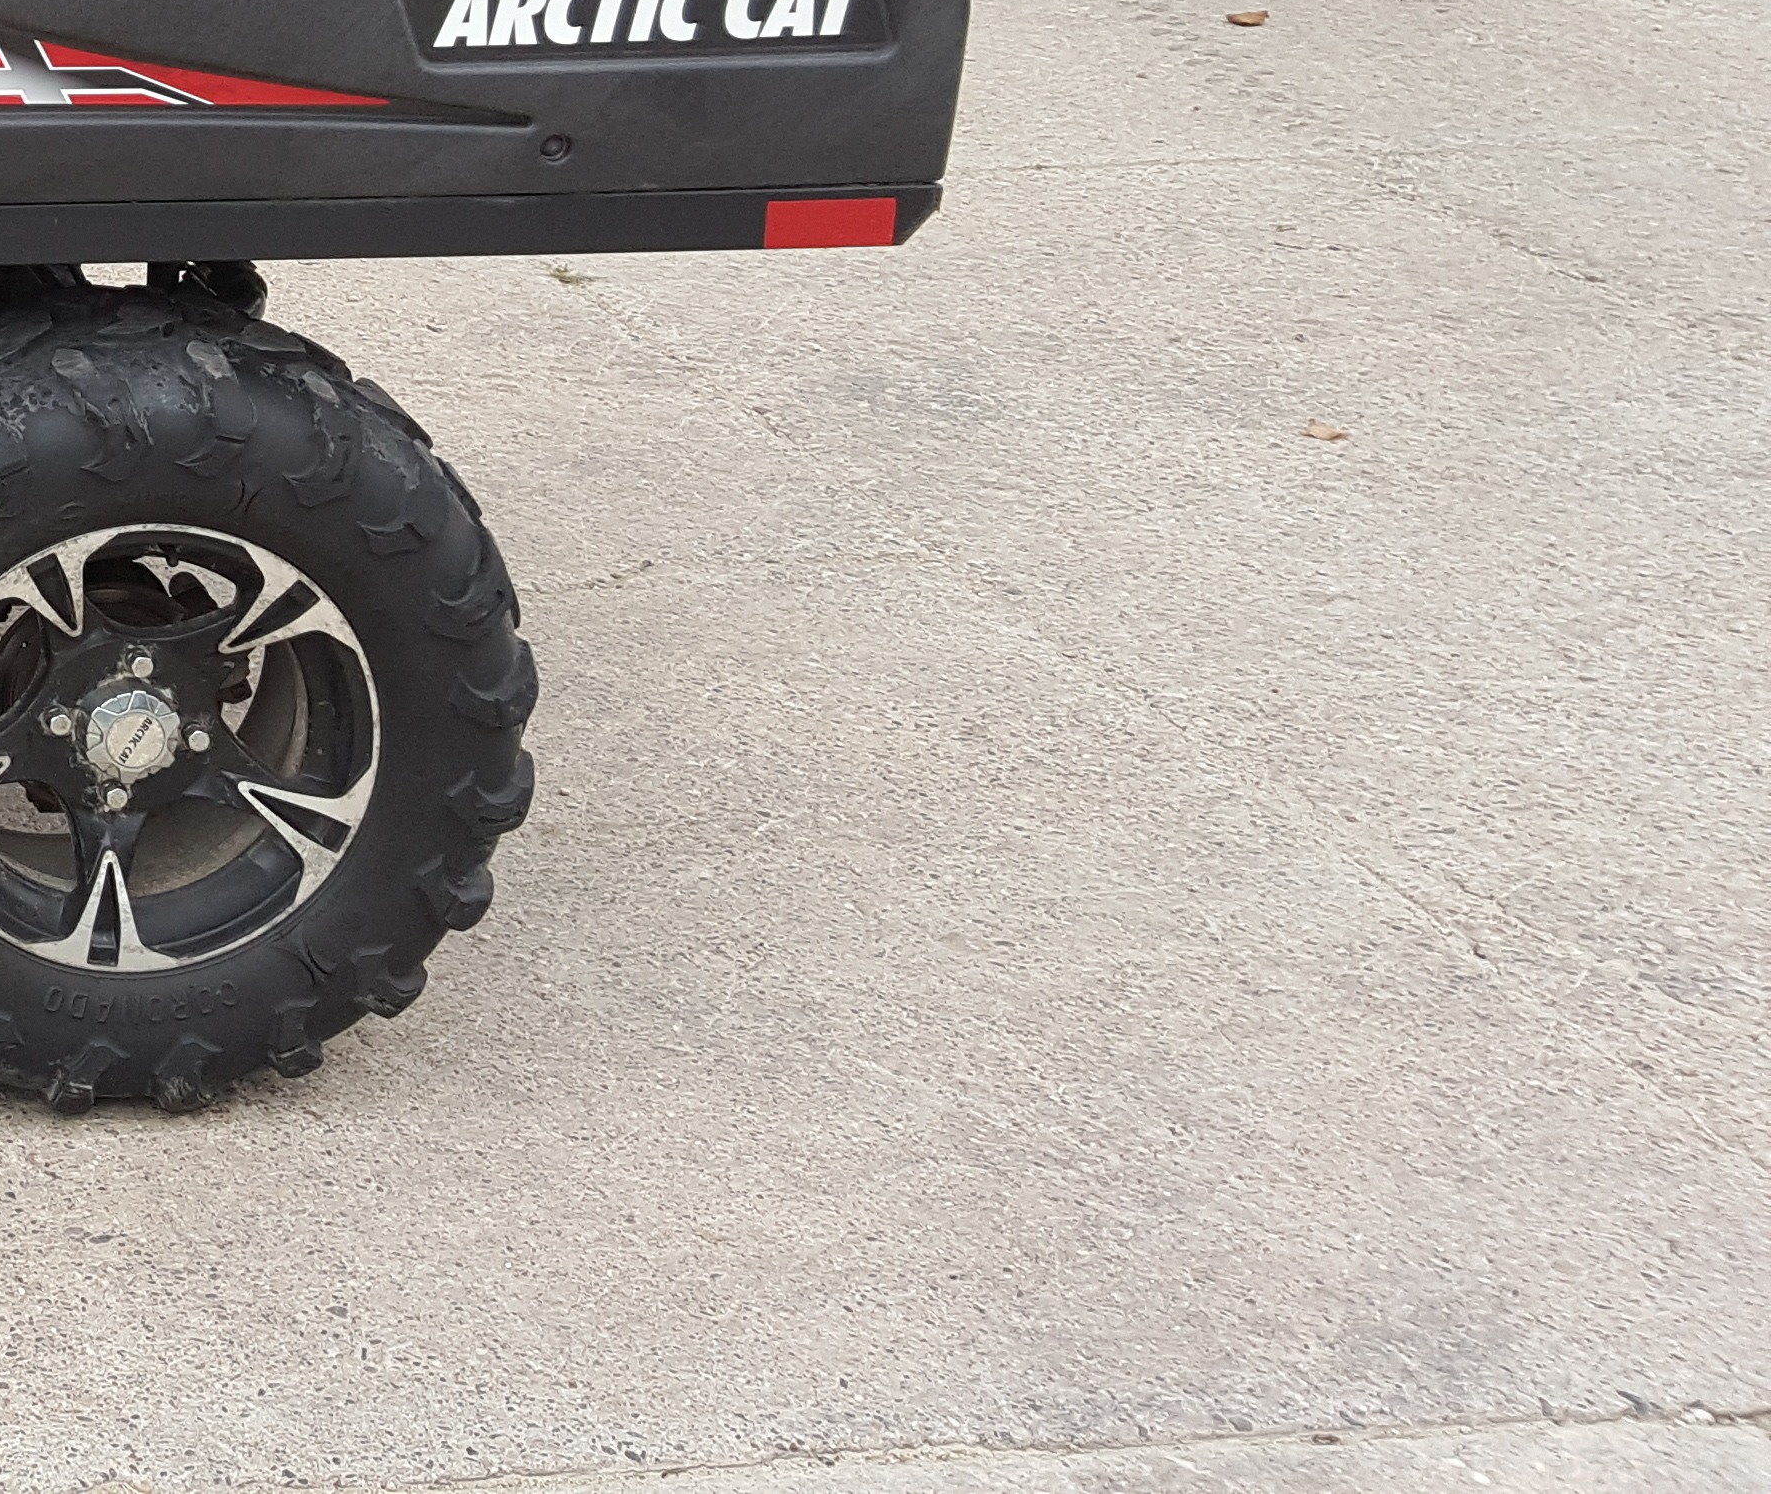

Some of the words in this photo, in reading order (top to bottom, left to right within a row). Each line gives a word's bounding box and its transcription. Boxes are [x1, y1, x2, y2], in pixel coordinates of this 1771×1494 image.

[128, 716, 153, 748] ARCTIC
[118, 746, 133, 764] CAT
[43, 978, 239, 1024] CORONADO
